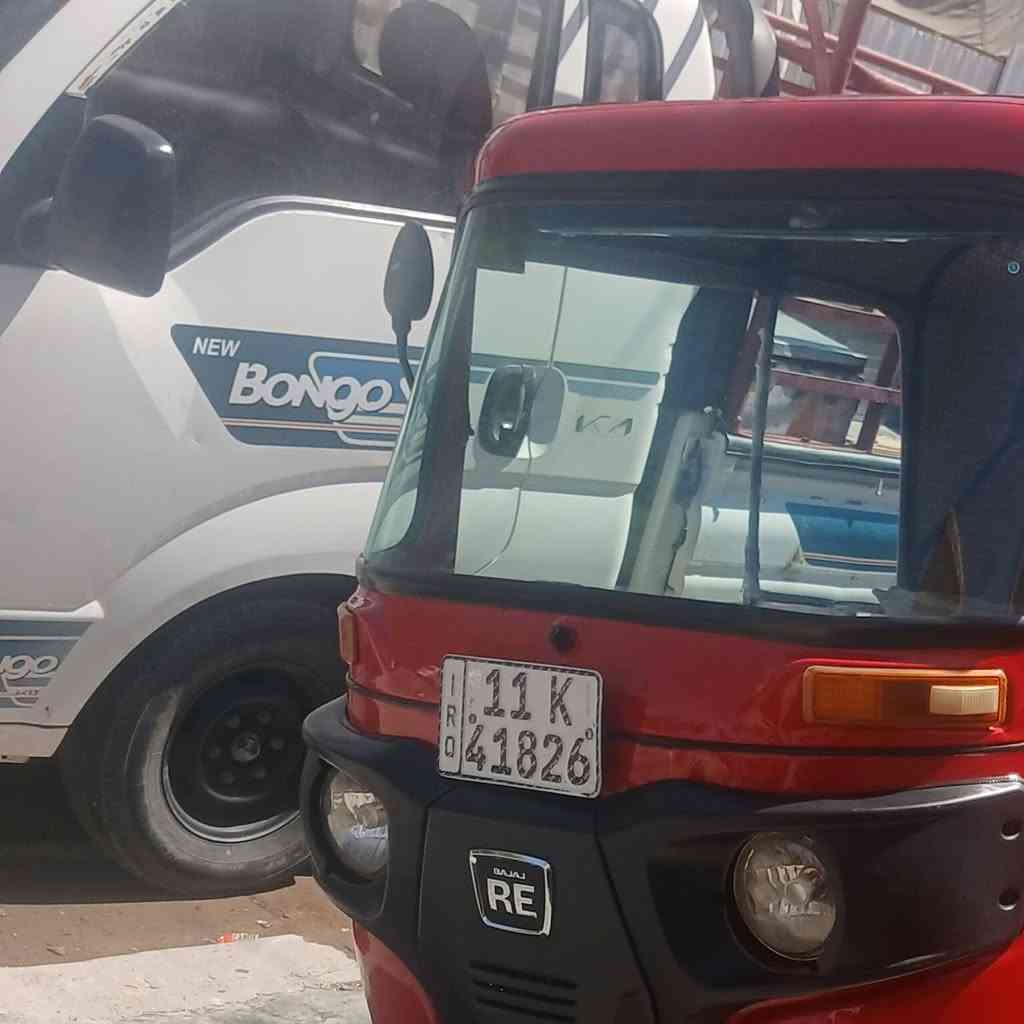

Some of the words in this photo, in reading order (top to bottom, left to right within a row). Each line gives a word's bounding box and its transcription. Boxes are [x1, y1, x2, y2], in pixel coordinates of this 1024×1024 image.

[193, 337, 241, 357] NEW
[444, 674, 457, 758] IRQ
[483, 669, 532, 720] 11
[550, 675, 573, 726] K
[465, 724, 590, 786] 41826
[487, 878, 538, 918] RE
